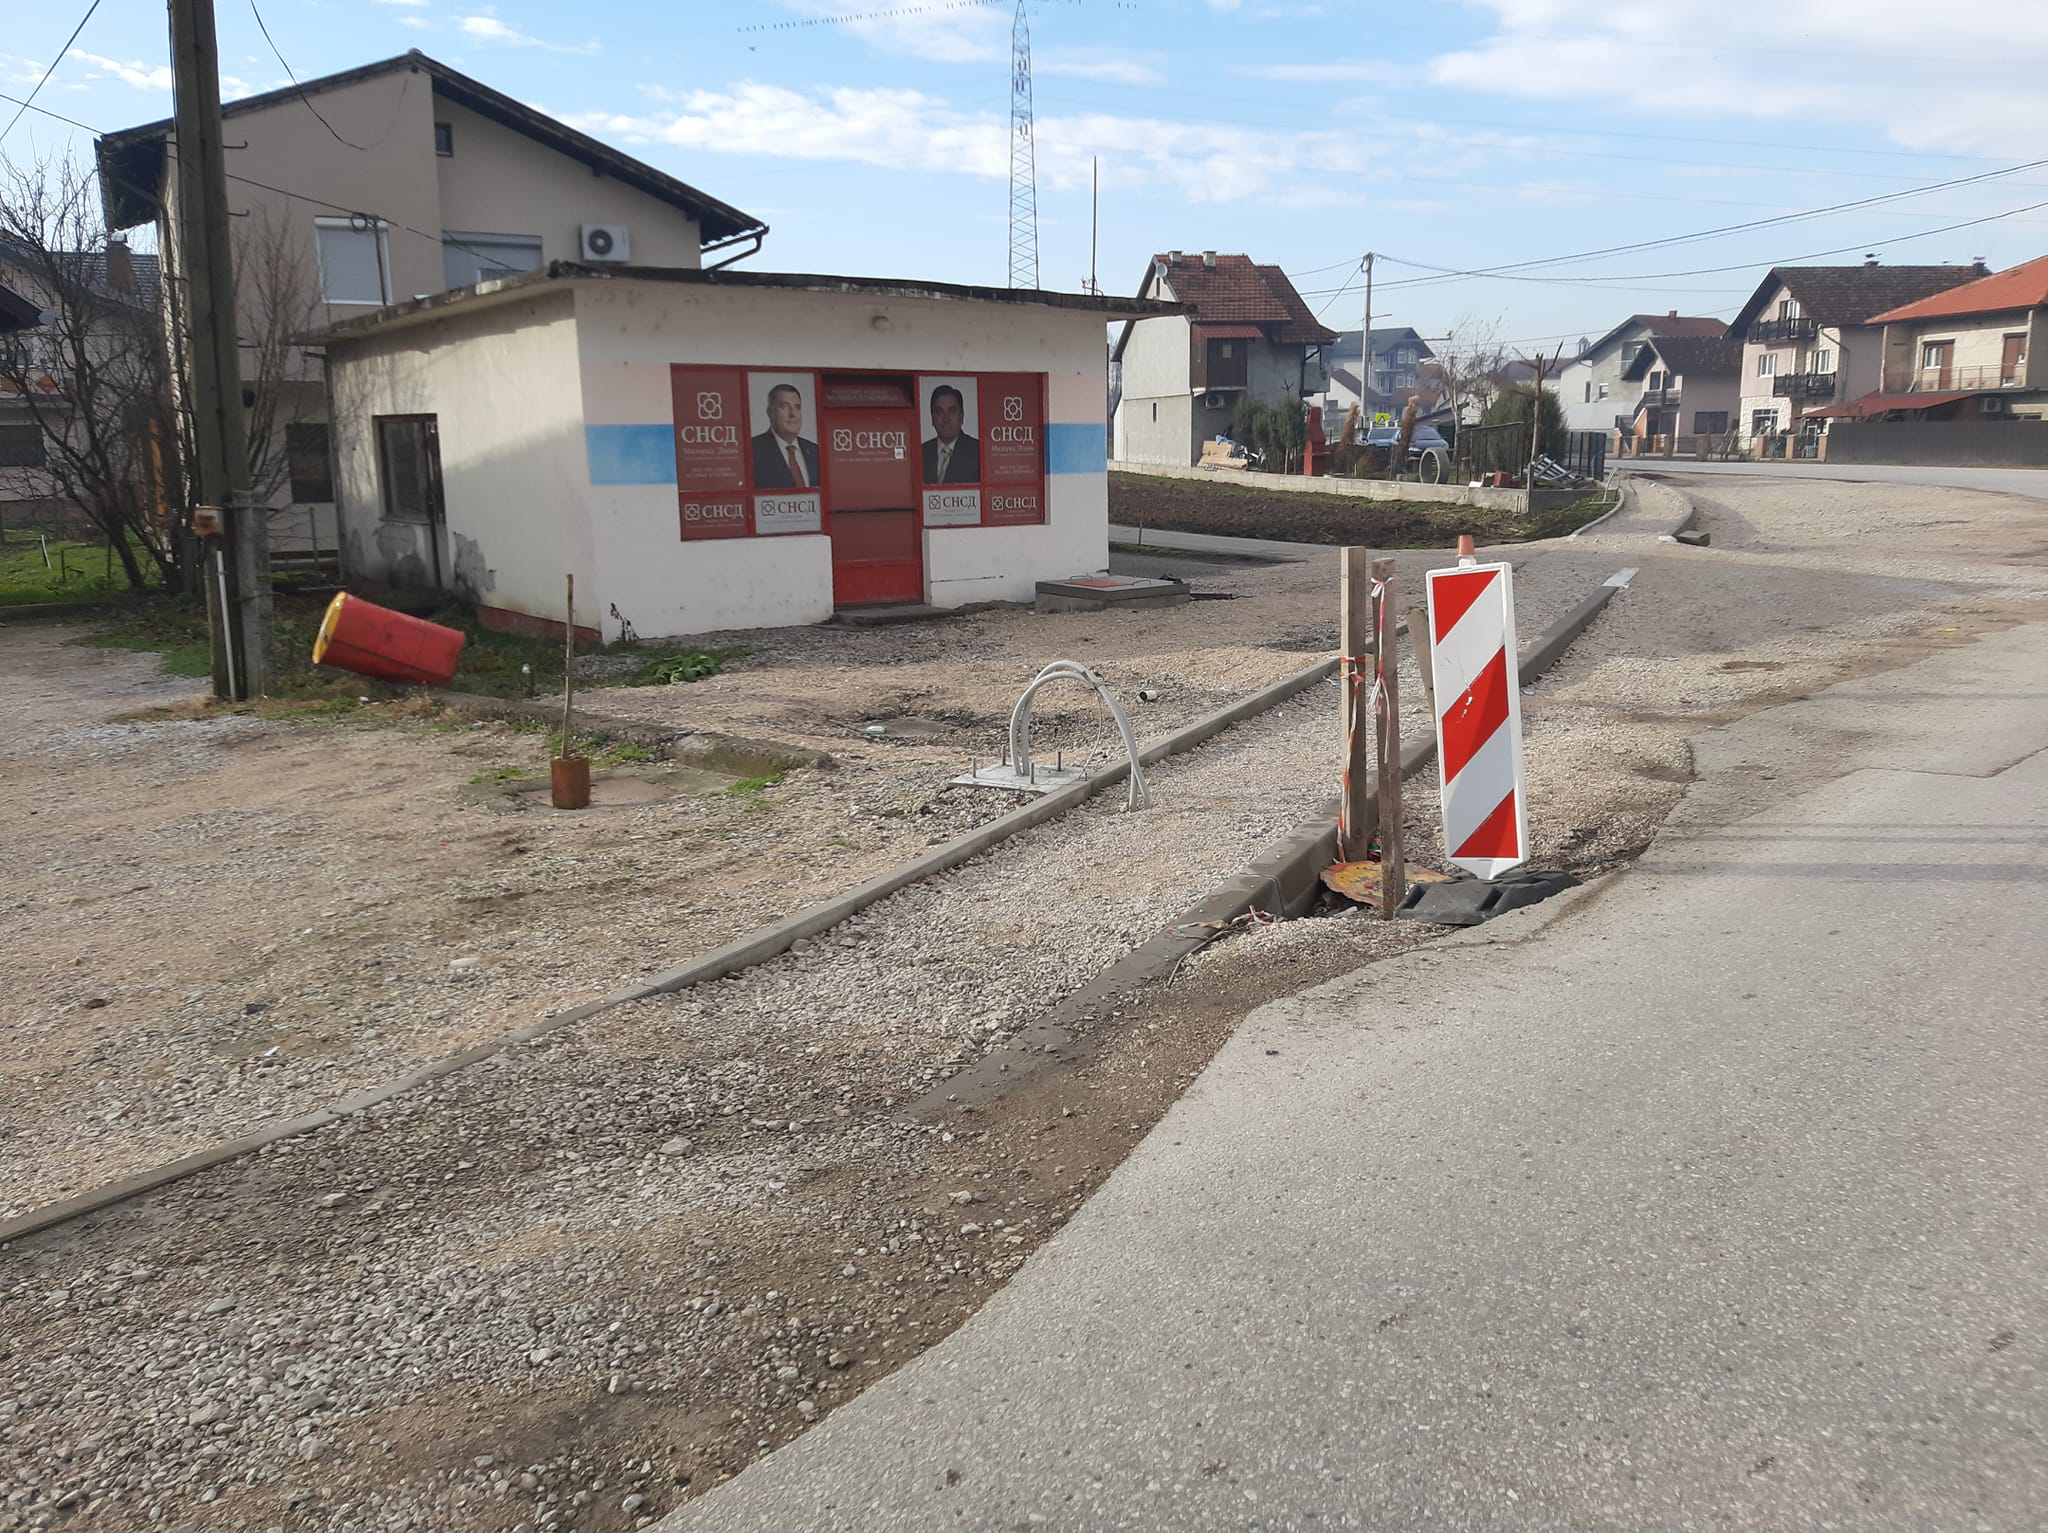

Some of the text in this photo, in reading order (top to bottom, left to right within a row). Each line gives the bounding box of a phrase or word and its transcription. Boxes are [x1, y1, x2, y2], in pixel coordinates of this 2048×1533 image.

[681, 426, 738, 446] СНСД
[856, 431, 906, 451] СНСД
[991, 426, 1034, 444] СНСД
[778, 500, 817, 514] СНСД
[943, 496, 977, 509] СНСД
[1005, 496, 1037, 510] СНСД
[702, 504, 744, 519] СНСД
